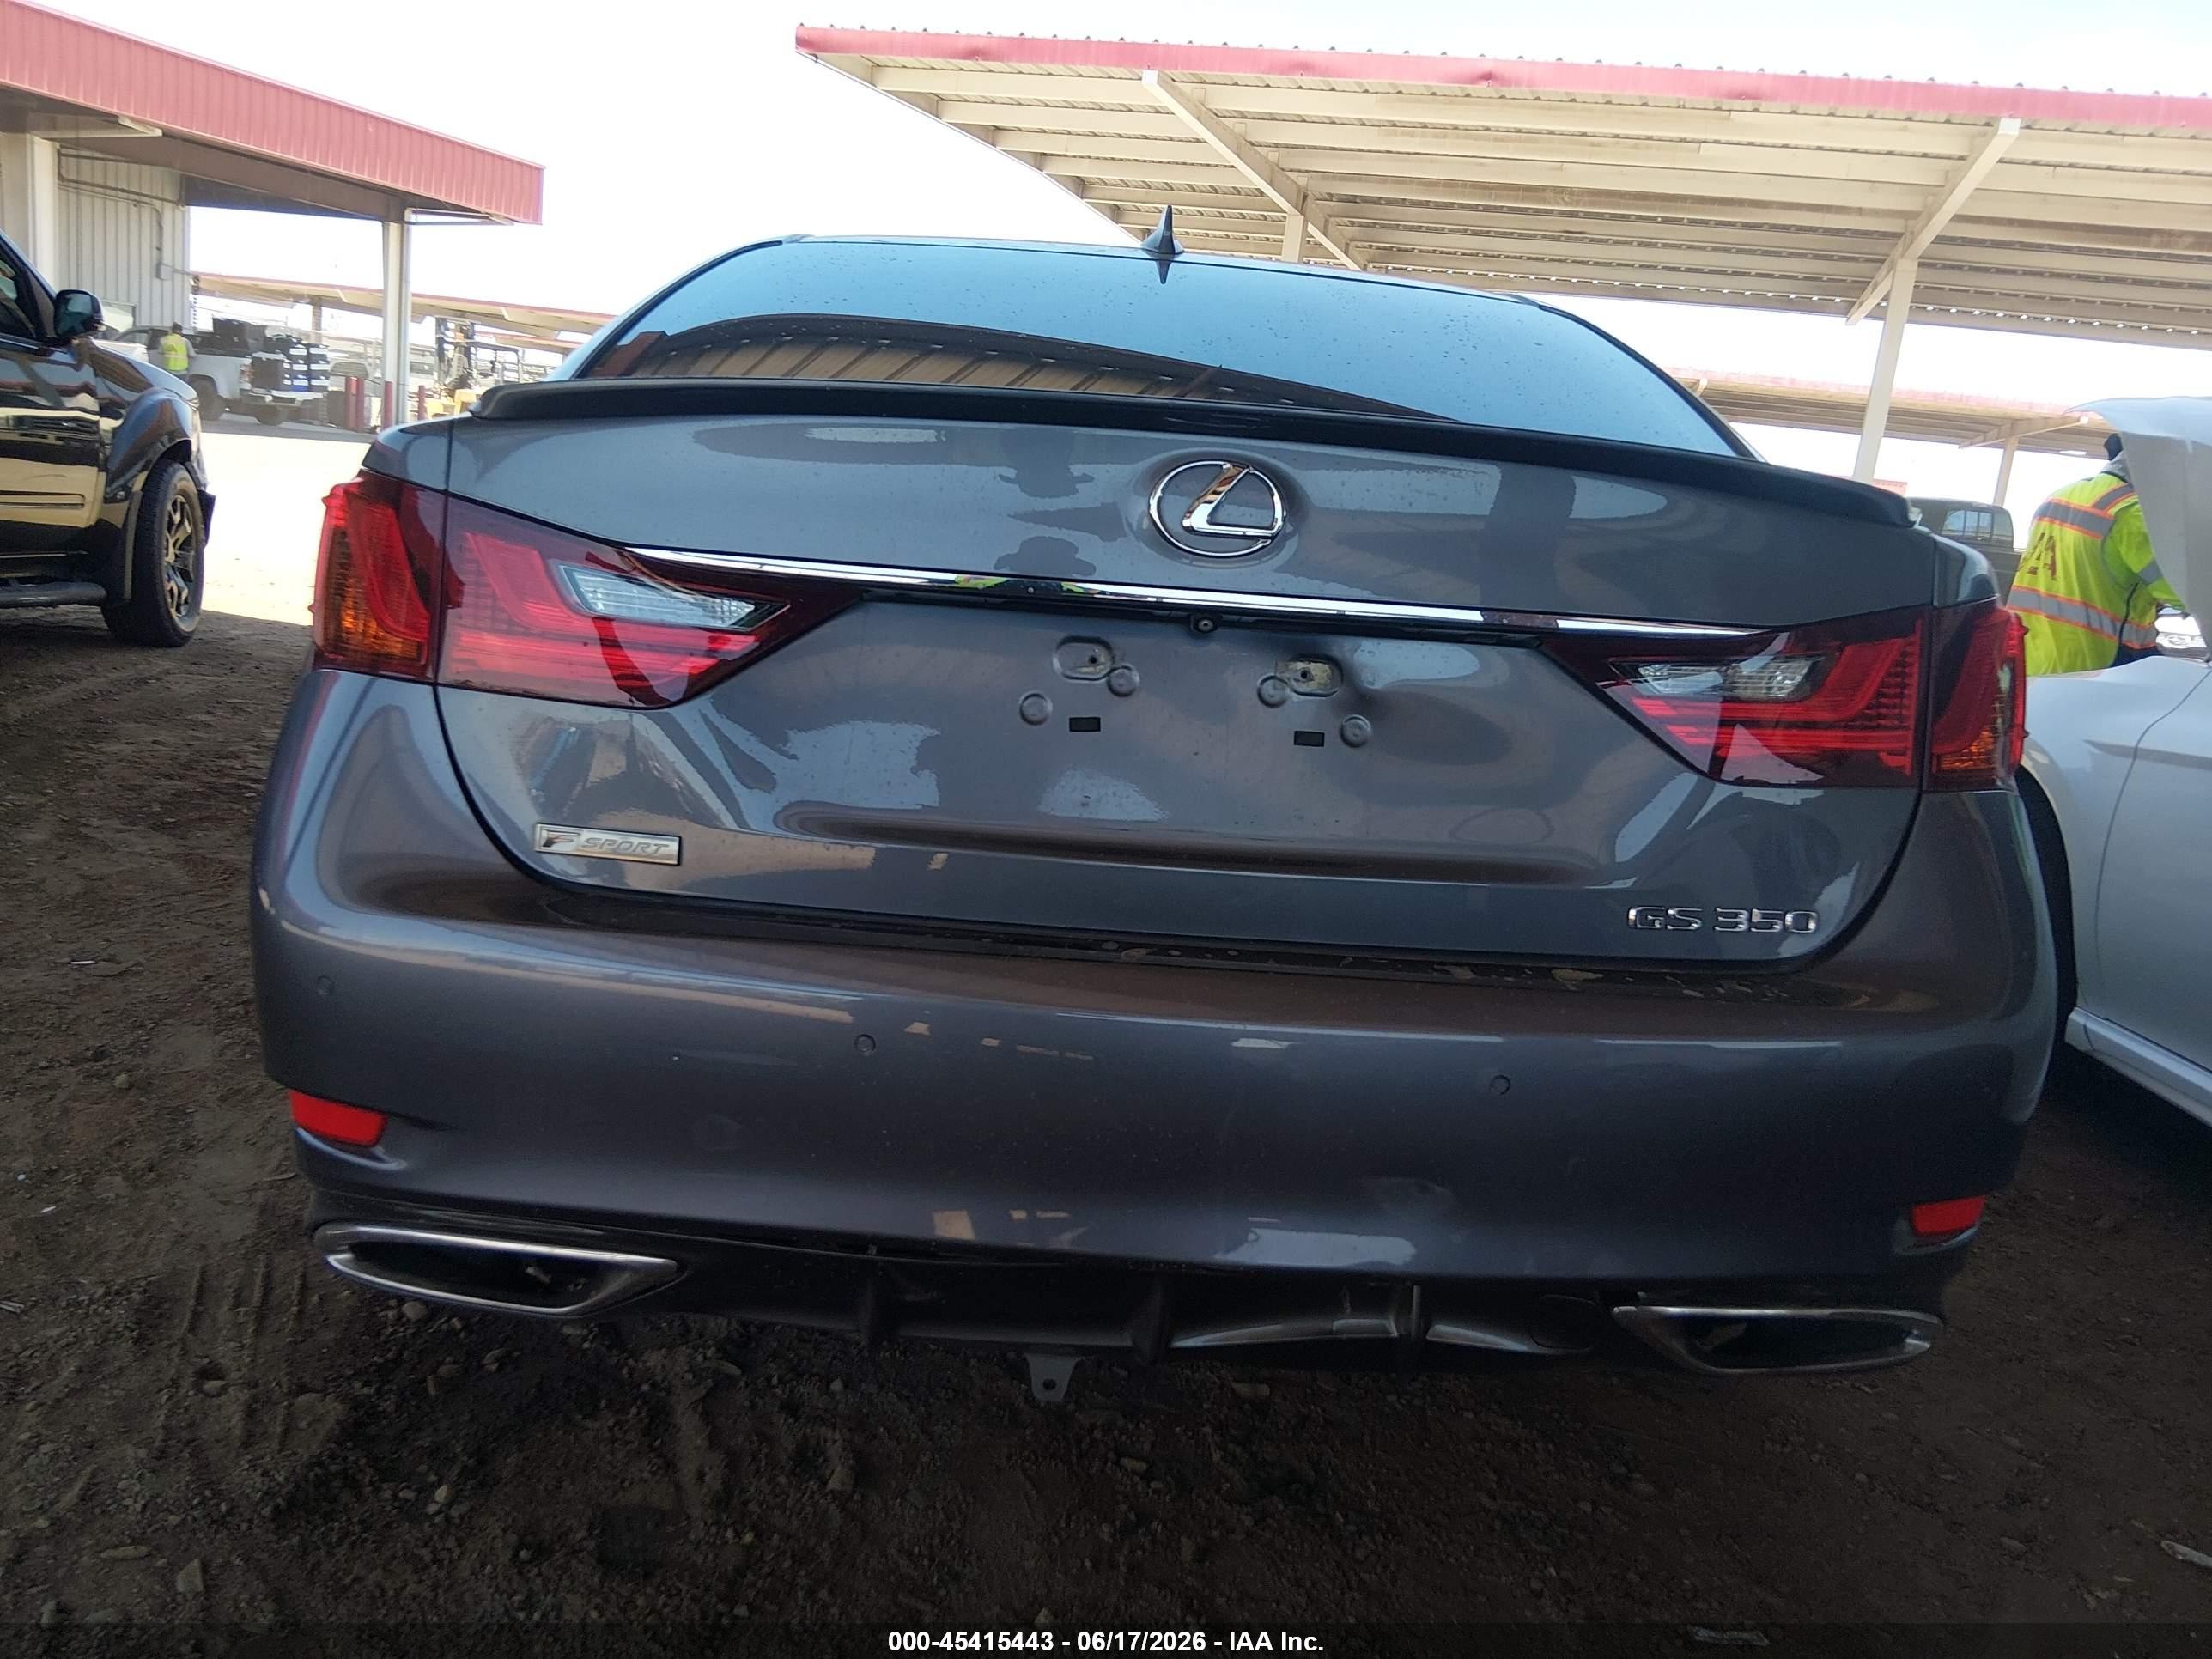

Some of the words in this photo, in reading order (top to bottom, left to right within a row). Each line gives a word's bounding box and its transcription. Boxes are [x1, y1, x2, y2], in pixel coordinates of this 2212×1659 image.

[581, 837, 670, 855] SPORT
[1627, 906, 1703, 931] GS
[1715, 907, 1819, 933] 350
